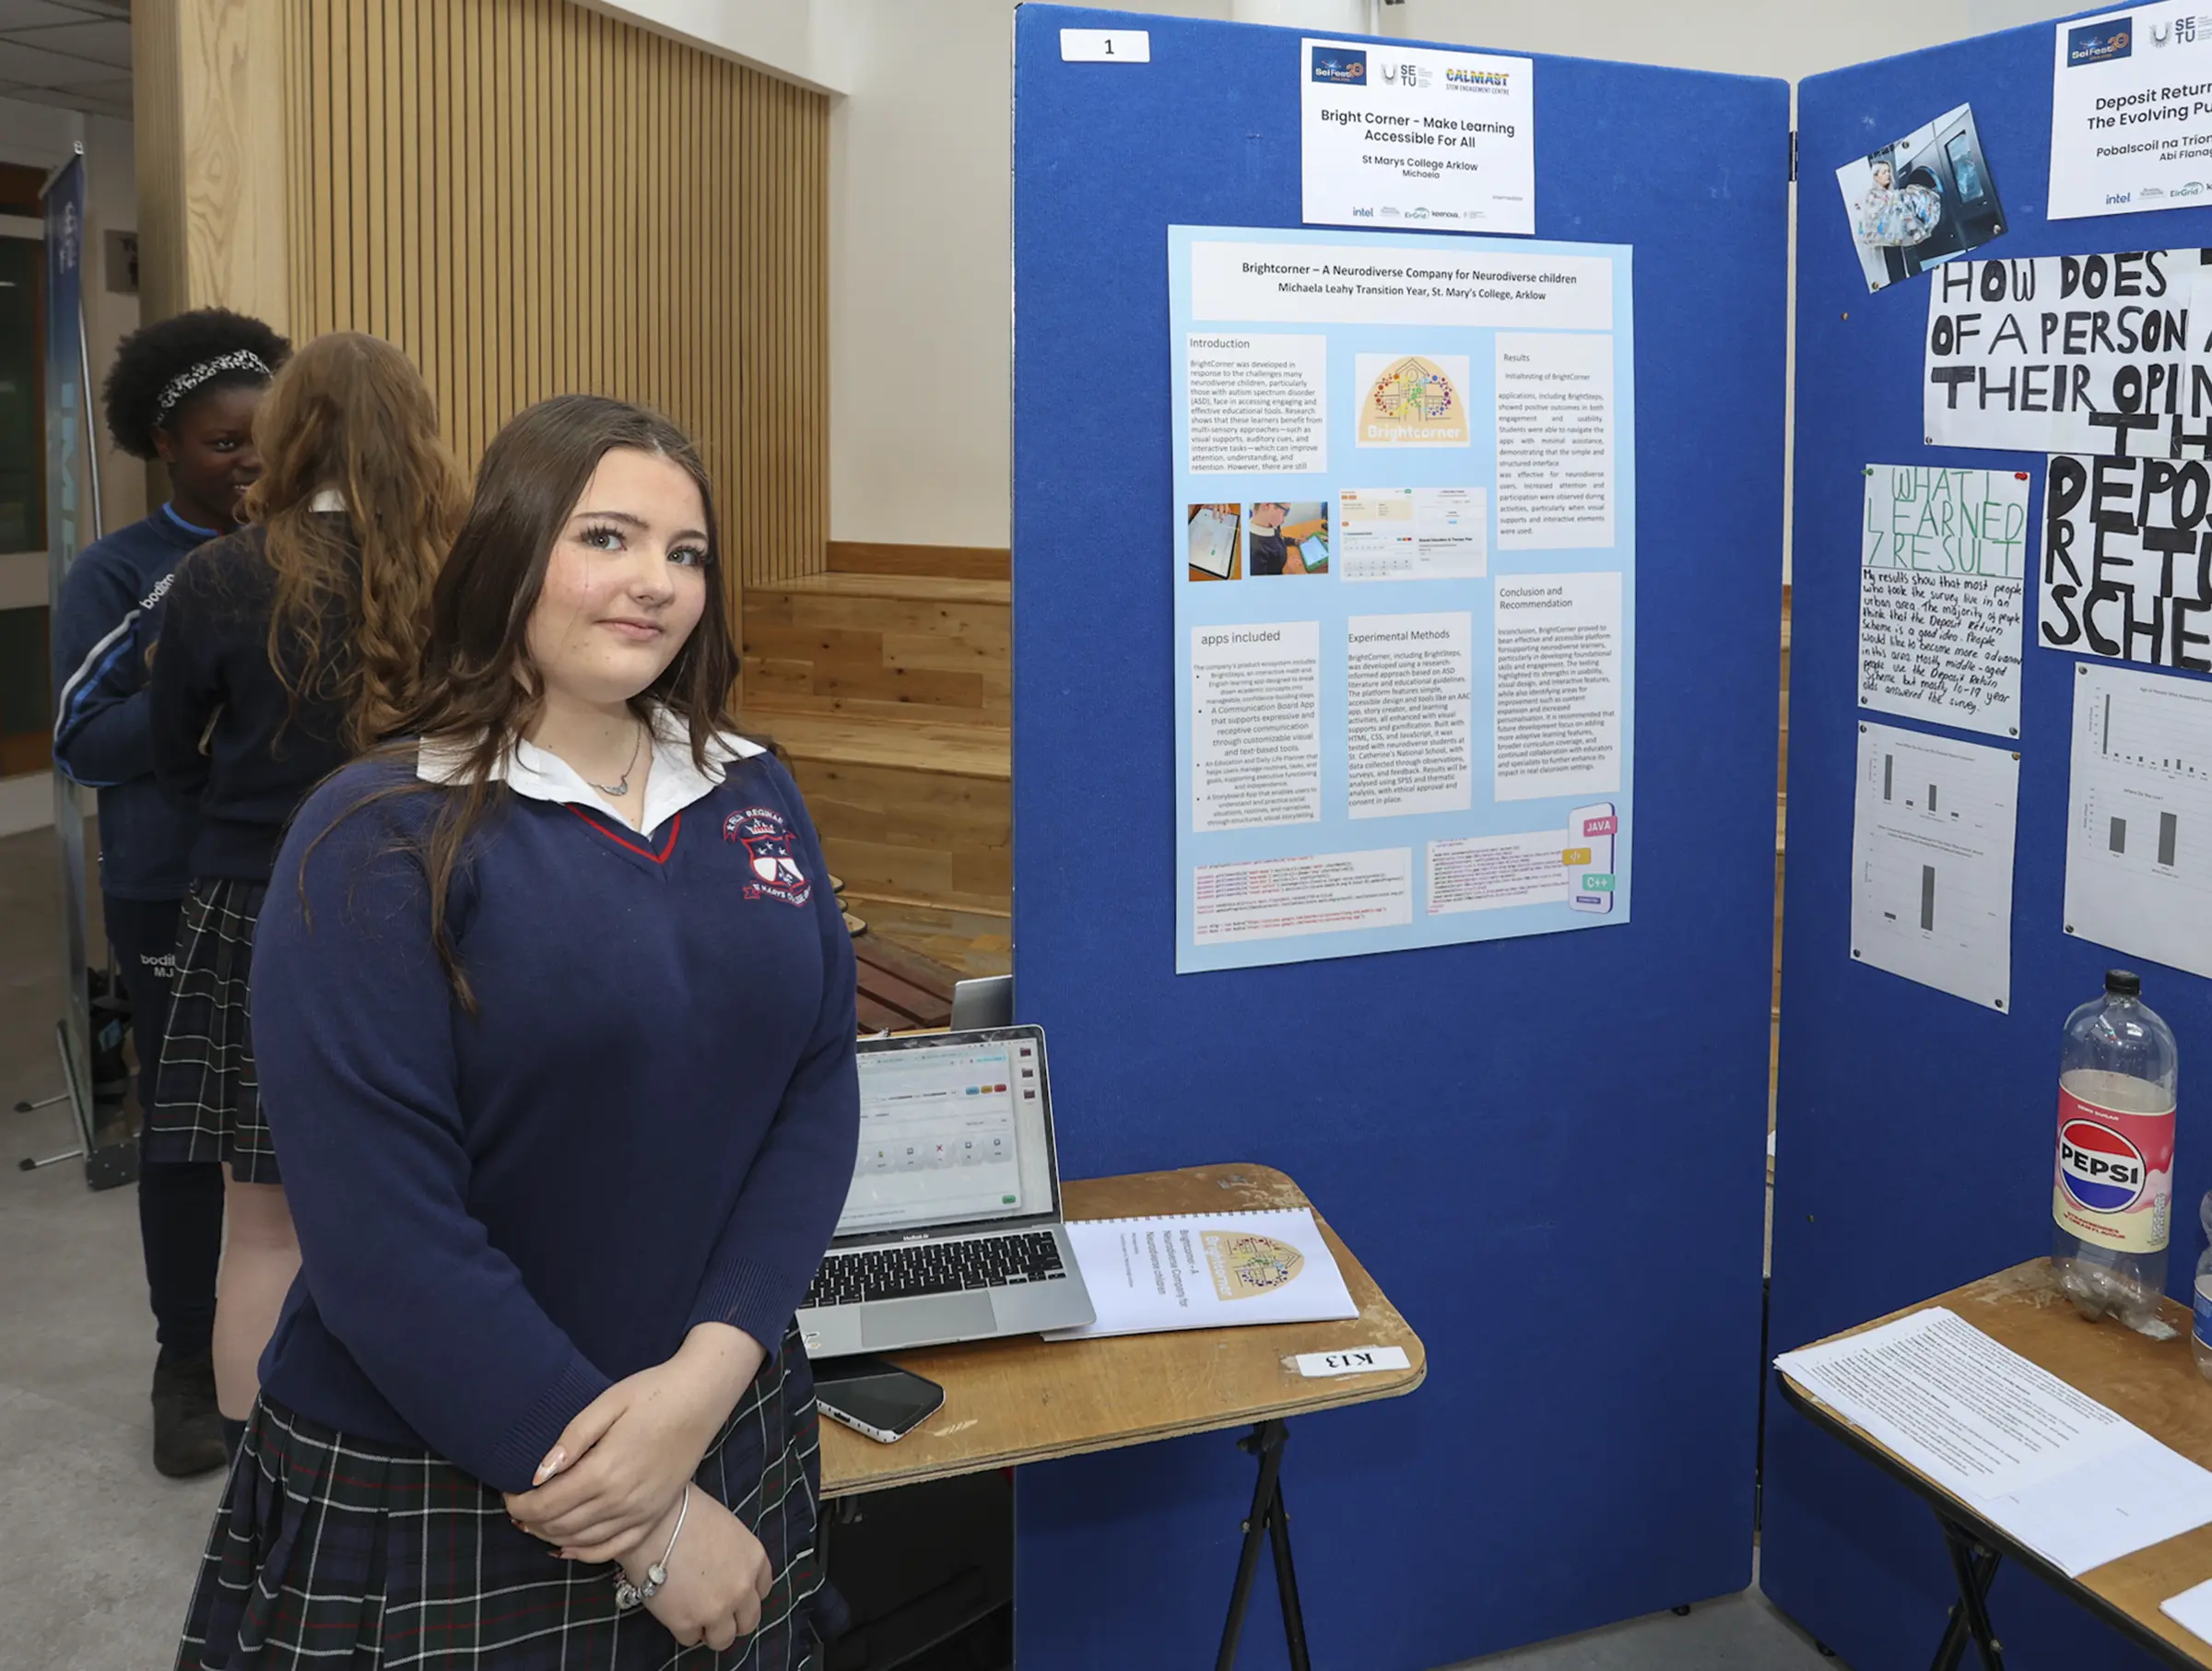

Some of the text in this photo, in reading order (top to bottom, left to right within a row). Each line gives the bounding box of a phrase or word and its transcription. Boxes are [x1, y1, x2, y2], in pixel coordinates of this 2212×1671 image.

[2175, 17, 2196, 31] SE
[2175, 29, 2196, 44] TU
[1104, 39, 1114, 54] 1
[1400, 65, 1417, 76] SE
[1445, 68, 1510, 86] CALMAST
[1400, 76, 1417, 87] TU
[2095, 90, 2157, 111] Deposit
[1321, 110, 1361, 125] Bright
[1364, 112, 1409, 125] Corner
[1423, 117, 1457, 129] Make
[1460, 121, 1514, 137] Learning
[2087, 116, 2116, 129] The
[2119, 106, 2191, 124] Evolving
[1364, 130, 1475, 147] Accessible For All
[2096, 140, 2159, 156] Pobalscoil
[2161, 139, 2180, 148] na
[2159, 150, 2177, 160] Abi
[1362, 155, 1477, 171] St Marys College Arklow
[1402, 170, 1440, 179] Michaela
[2106, 193, 2131, 206] intel
[2171, 187, 2199, 197] EirGrid
[1352, 206, 1373, 218] intel
[1241, 263, 1310, 275] Brightcorner
[1322, 265, 1330, 275] A
[1332, 265, 1403, 277] Neurodiverse
[1406, 267, 1453, 280] Company
[1455, 269, 1469, 279] for
[1472, 271, 1536, 282] Neurodiverse
[1538, 273, 1576, 283] children
[1943, 250, 2168, 303] HOW DOES
[1277, 282, 1546, 300] Michaela Leahy Transition Year, St. Mary's College, Arklow
[1931, 313, 1982, 356] OF
[1988, 313, 2028, 355] A
[2041, 306, 2187, 355] PERSON
[1190, 338, 1250, 348] Introduction
[1190, 359, 1234, 369] BrightCorner
[1503, 353, 1530, 361] Results
[1931, 364, 2097, 412] THEIR
[1367, 424, 1462, 441] Brightcorner
[1892, 467, 1973, 501] WHAT
[2047, 455, 2212, 531] DEPO
[1862, 569, 2022, 596] My results show that most people
[1499, 586, 1562, 597] Conclusion and
[1863, 582, 2010, 607] who took the survey live in an
[1500, 599, 1572, 609] Recommendation
[1200, 630, 1281, 646] apps included
[1347, 630, 1450, 643] Experimental Methods
[1217, 704, 1276, 713] Communication
[1277, 701, 1299, 710] Board
[1300, 700, 1315, 709] App
[1587, 820, 1611, 832] JAVA
[1587, 877, 1607, 888] C++
[155, 967, 174, 978] MJ
[2062, 1142, 2138, 1184] PEPSI
[1325, 1353, 1374, 1368] K13
